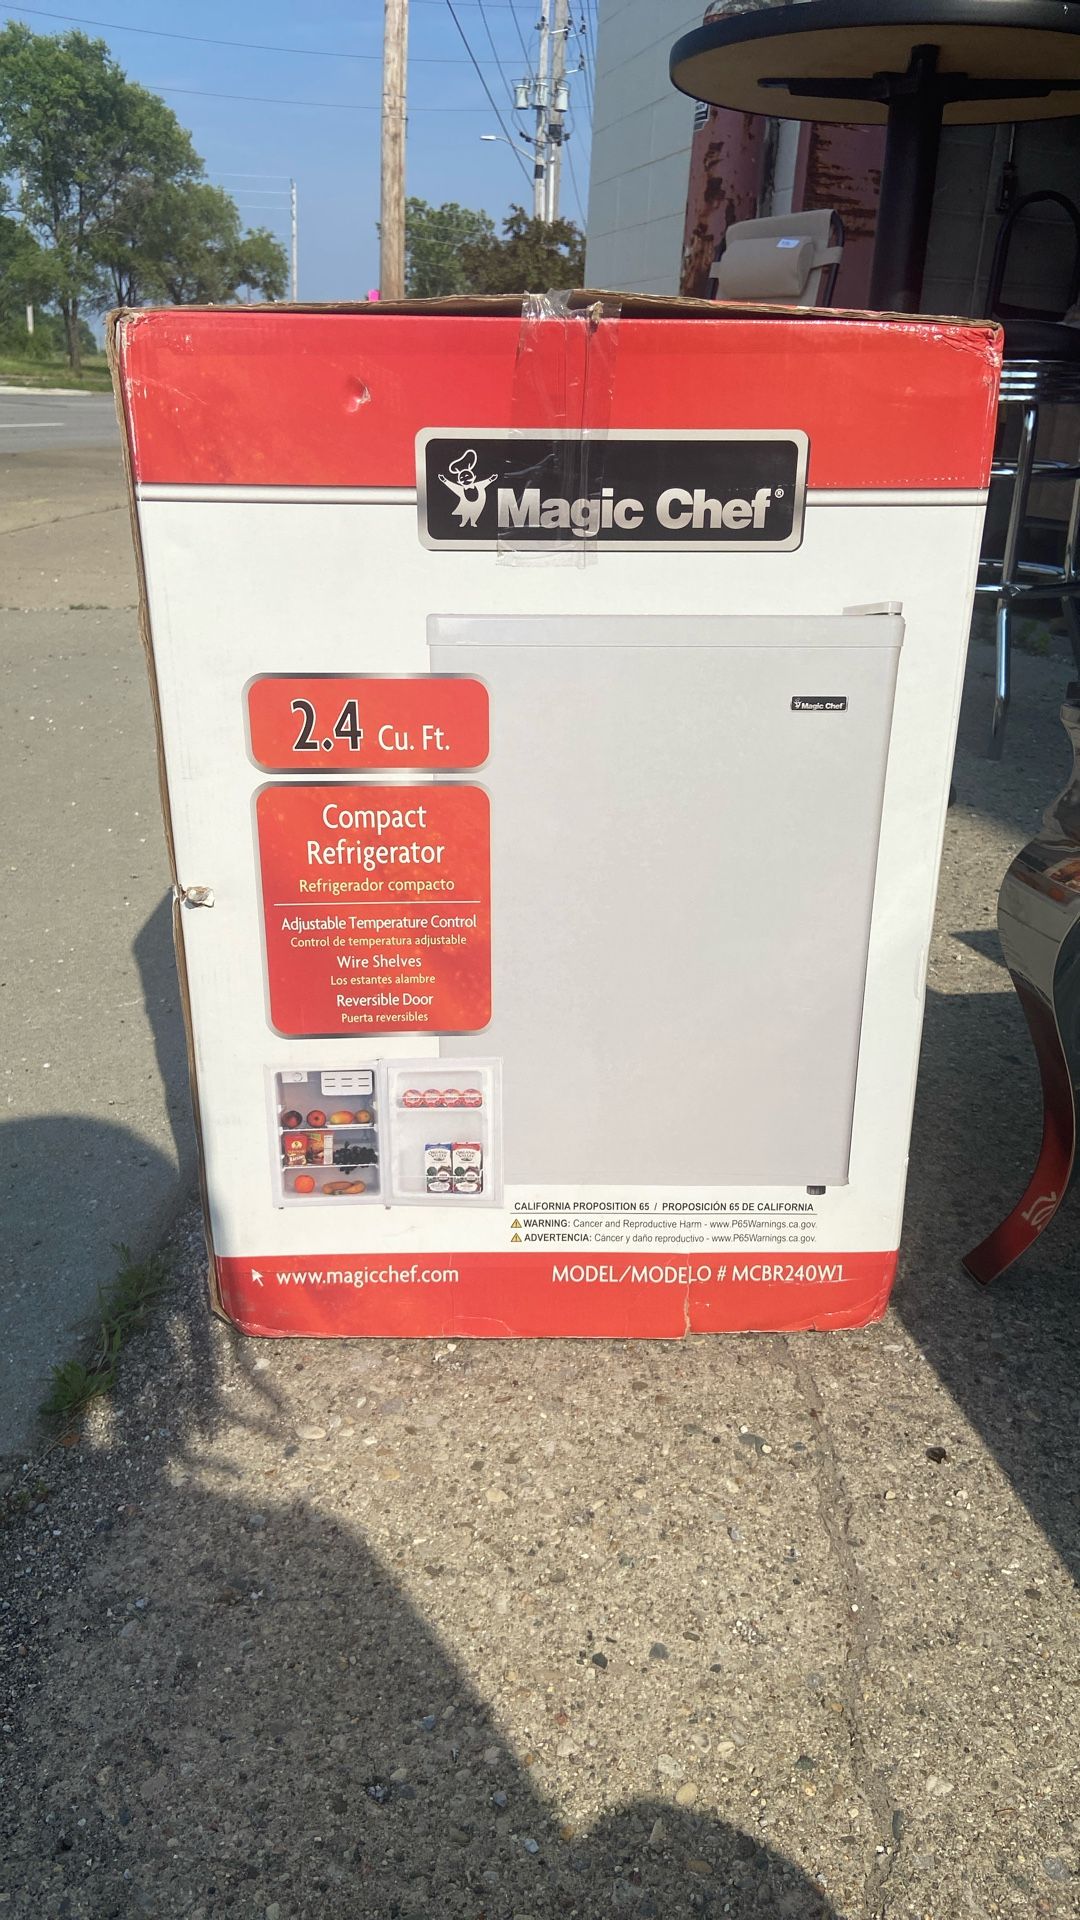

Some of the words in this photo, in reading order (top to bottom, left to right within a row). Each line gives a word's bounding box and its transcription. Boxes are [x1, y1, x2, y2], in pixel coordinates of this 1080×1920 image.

[497, 487, 644, 537] Magic
[801, 702, 824, 711] Magic
[290, 697, 363, 752] 2.4
[378, 724, 415, 751] Cu.
[422, 724, 450, 751] Ft.
[322, 803, 427, 835] Compact
[306, 838, 445, 872] Refrigerator
[299, 877, 384, 896] Refrigerador
[388, 878, 455, 895] compacto
[281, 916, 347, 934] Adjustable
[349, 915, 428, 933] Temperature
[430, 914, 478, 929] Control
[290, 936, 330, 948] Control
[333, 935, 346, 947] de
[348, 936, 412, 949] temperatura
[414, 933, 467, 948] adjustable
[336, 955, 369, 969] Wire
[372, 953, 422, 968] Shelves
[330, 975, 348, 986] Los
[350, 975, 393, 986] estantes
[395, 974, 436, 985] alambre
[336, 992, 400, 1007] Reversible
[402, 992, 434, 1006] Door
[341, 1012, 373, 1024] Puerta
[376, 1011, 429, 1023] reversibles
[514, 1202, 571, 1211] CALIFORNIA
[573, 1202, 637, 1211] PROPOSITION
[639, 1202, 650, 1211] 65
[662, 1201, 727, 1211] PROPOSICIÓN
[729, 1202, 740, 1211] 65
[742, 1202, 755, 1211] DE
[757, 1202, 814, 1212] CALIFORNIA
[523, 1219, 571, 1228] WARNING:
[573, 1219, 603, 1228] Cancer
[605, 1219, 621, 1228] and
[623, 1219, 677, 1230] Reproductive
[679, 1219, 702, 1229] Harm
[524, 1233, 592, 1242] ADVERTENCIA:
[594, 1233, 623, 1242] Cáncer
[625, 1235, 630, 1244] y
[632, 1233, 653, 1242] daño
[654, 1233, 704, 1244] reproductivo
[276, 1264, 459, 1288] www.magicchef.com
[552, 1265, 711, 1285] MODEL/MODELO
[716, 1266, 726, 1282] #
[732, 1264, 843, 1282] MCBR240W1
